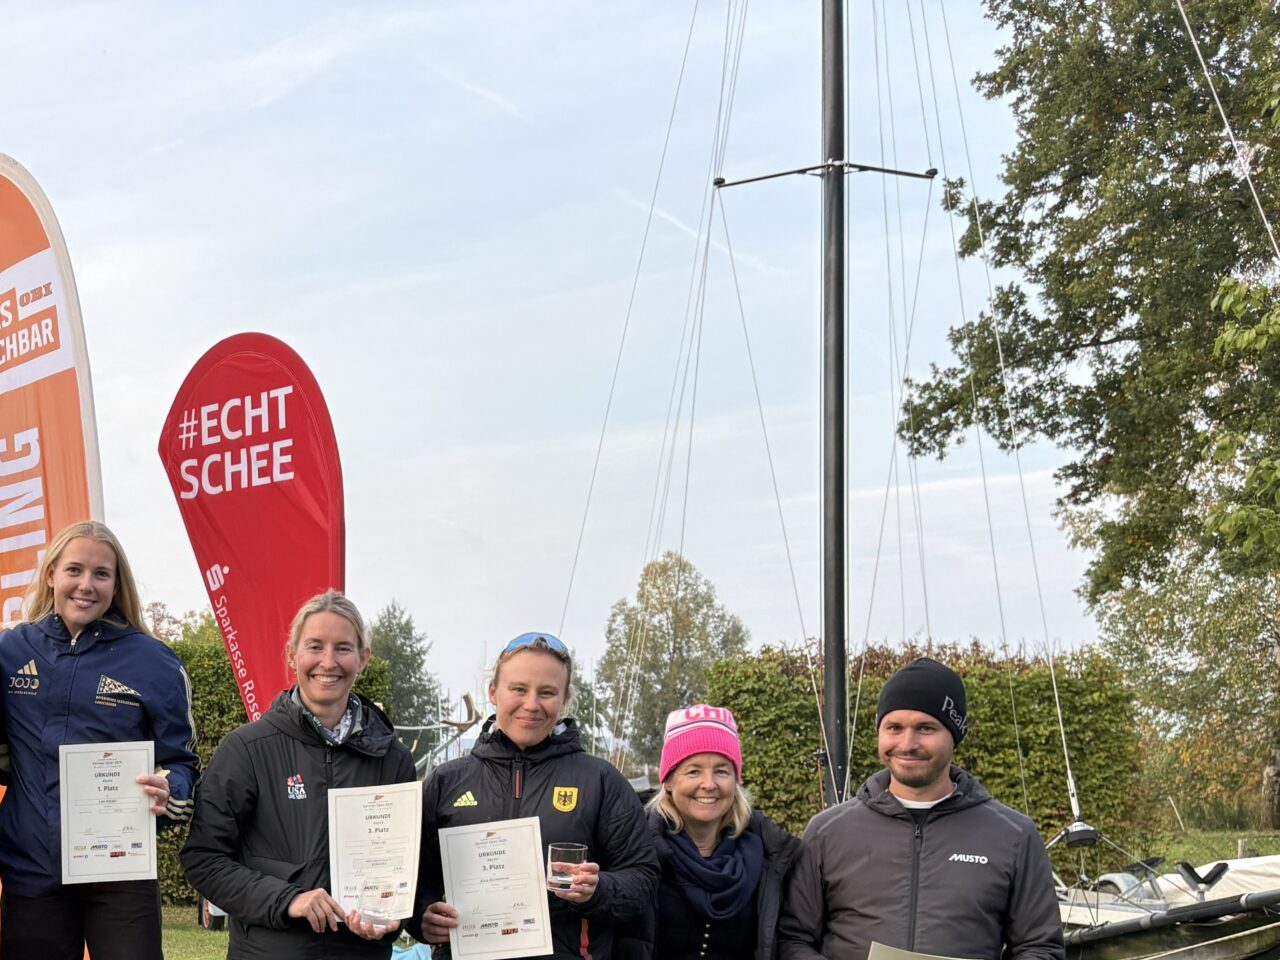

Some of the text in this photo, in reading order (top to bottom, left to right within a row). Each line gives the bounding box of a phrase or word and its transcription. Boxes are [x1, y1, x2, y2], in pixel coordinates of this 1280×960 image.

[19, 281, 53, 307] OBI
[178, 384, 293, 450] #ECHT
[180, 438, 295, 500] SCHEE
[215, 595, 247, 678] Sparkasse
[287, 784, 306, 795] USA
[949, 853, 988, 864] MUSTO
